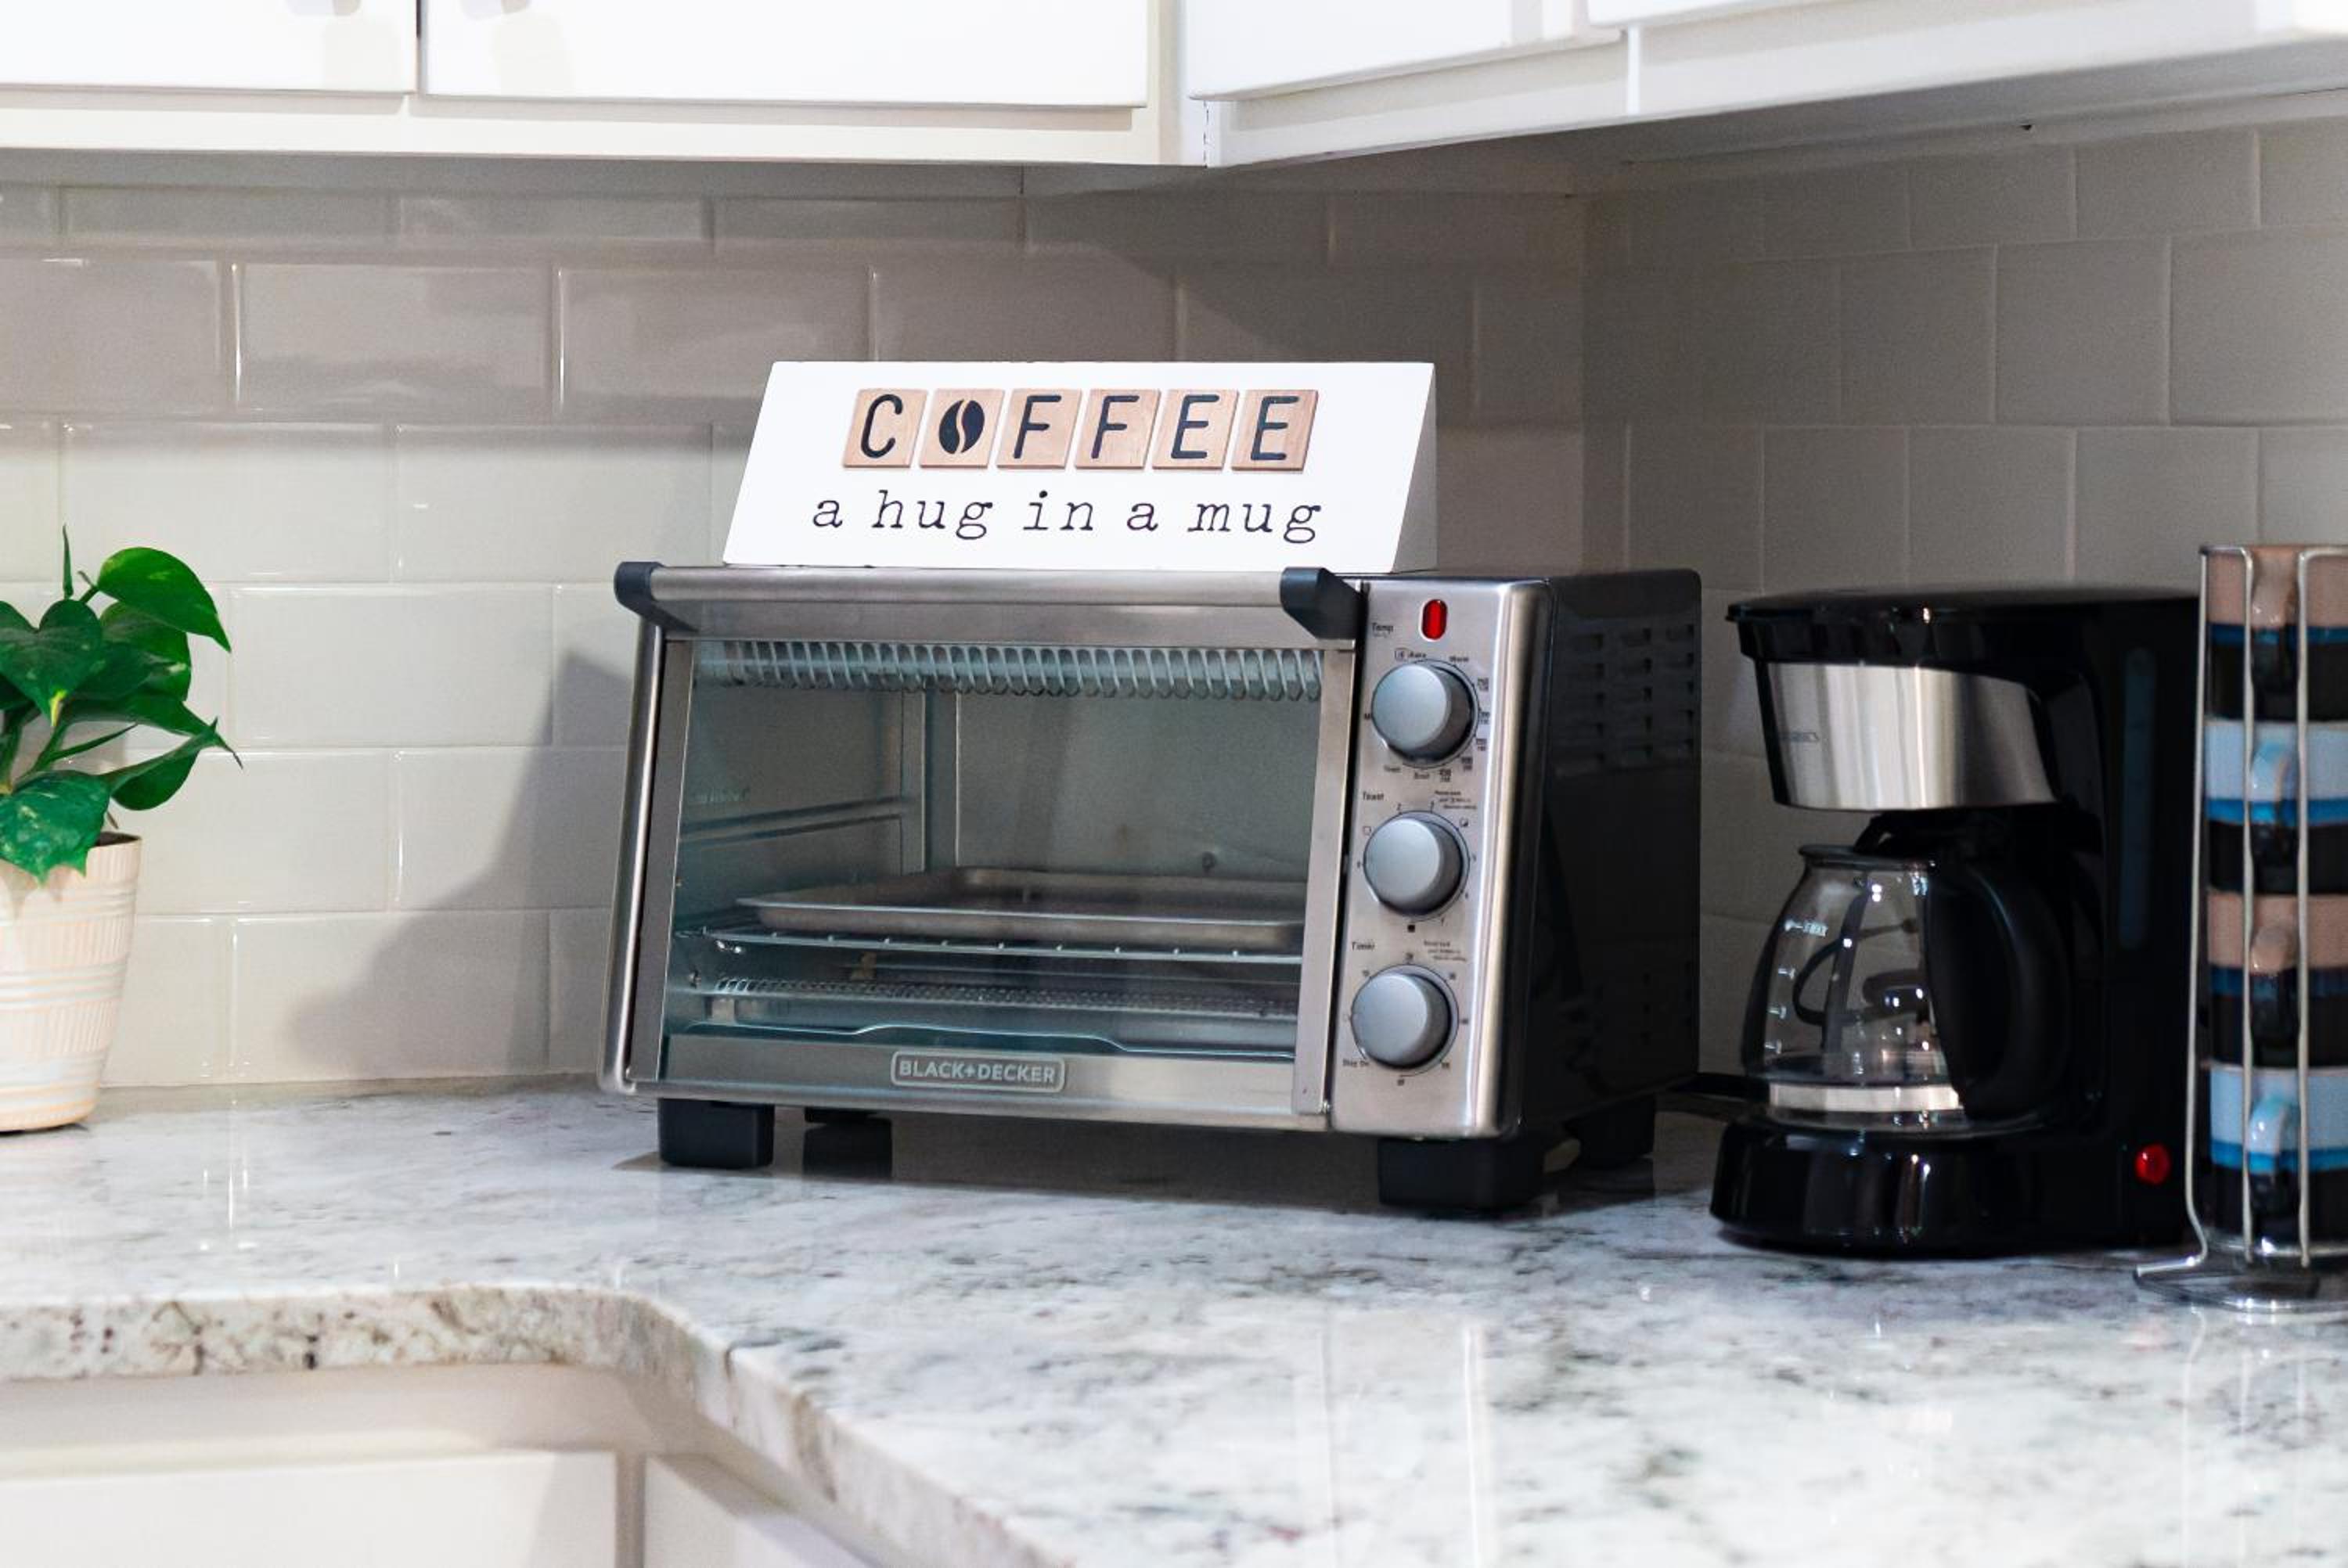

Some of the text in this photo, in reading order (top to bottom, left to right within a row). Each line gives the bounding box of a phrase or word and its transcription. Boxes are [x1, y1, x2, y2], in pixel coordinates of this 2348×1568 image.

[812, 489, 1322, 544] a hug in a mug
[899, 1060, 1056, 1083] BLACK+DECKER
